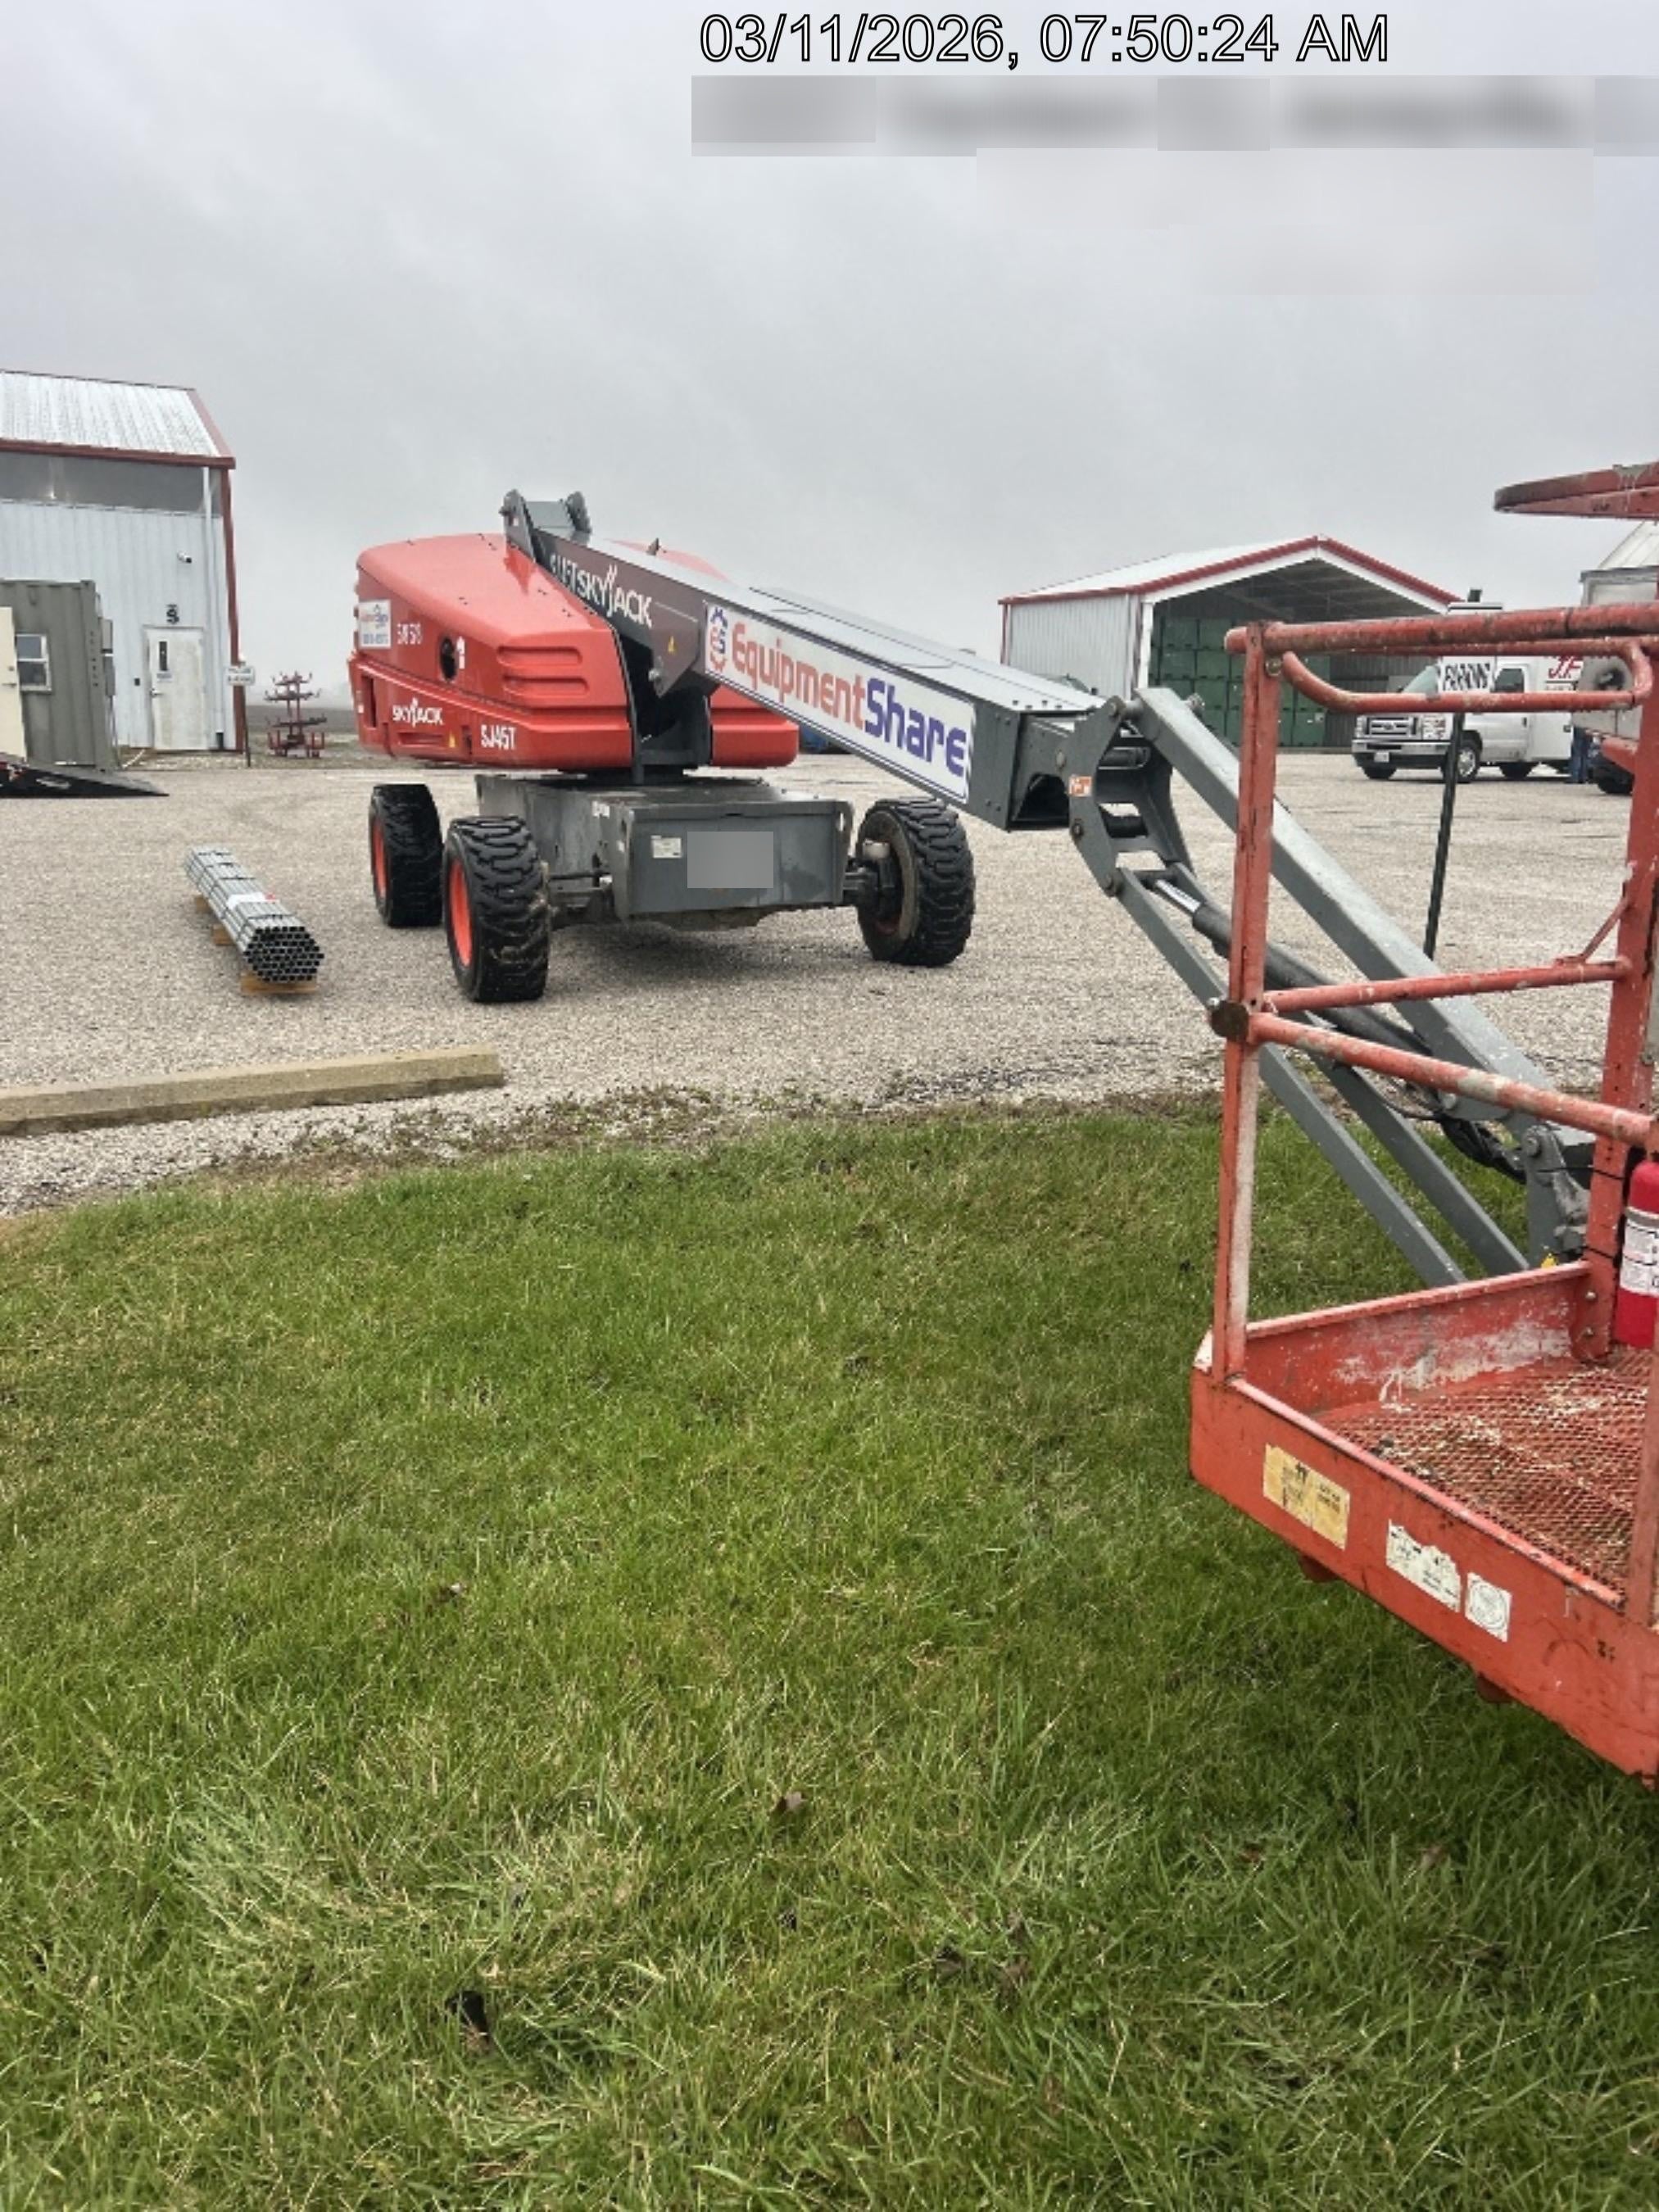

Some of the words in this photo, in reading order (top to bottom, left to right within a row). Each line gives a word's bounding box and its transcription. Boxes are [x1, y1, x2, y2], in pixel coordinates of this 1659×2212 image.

[577, 563, 653, 629] SKYJACK
[392, 696, 445, 728] SKYJACK
[731, 623, 968, 777] EquipmentShare
[480, 723, 516, 750] SJ45T
